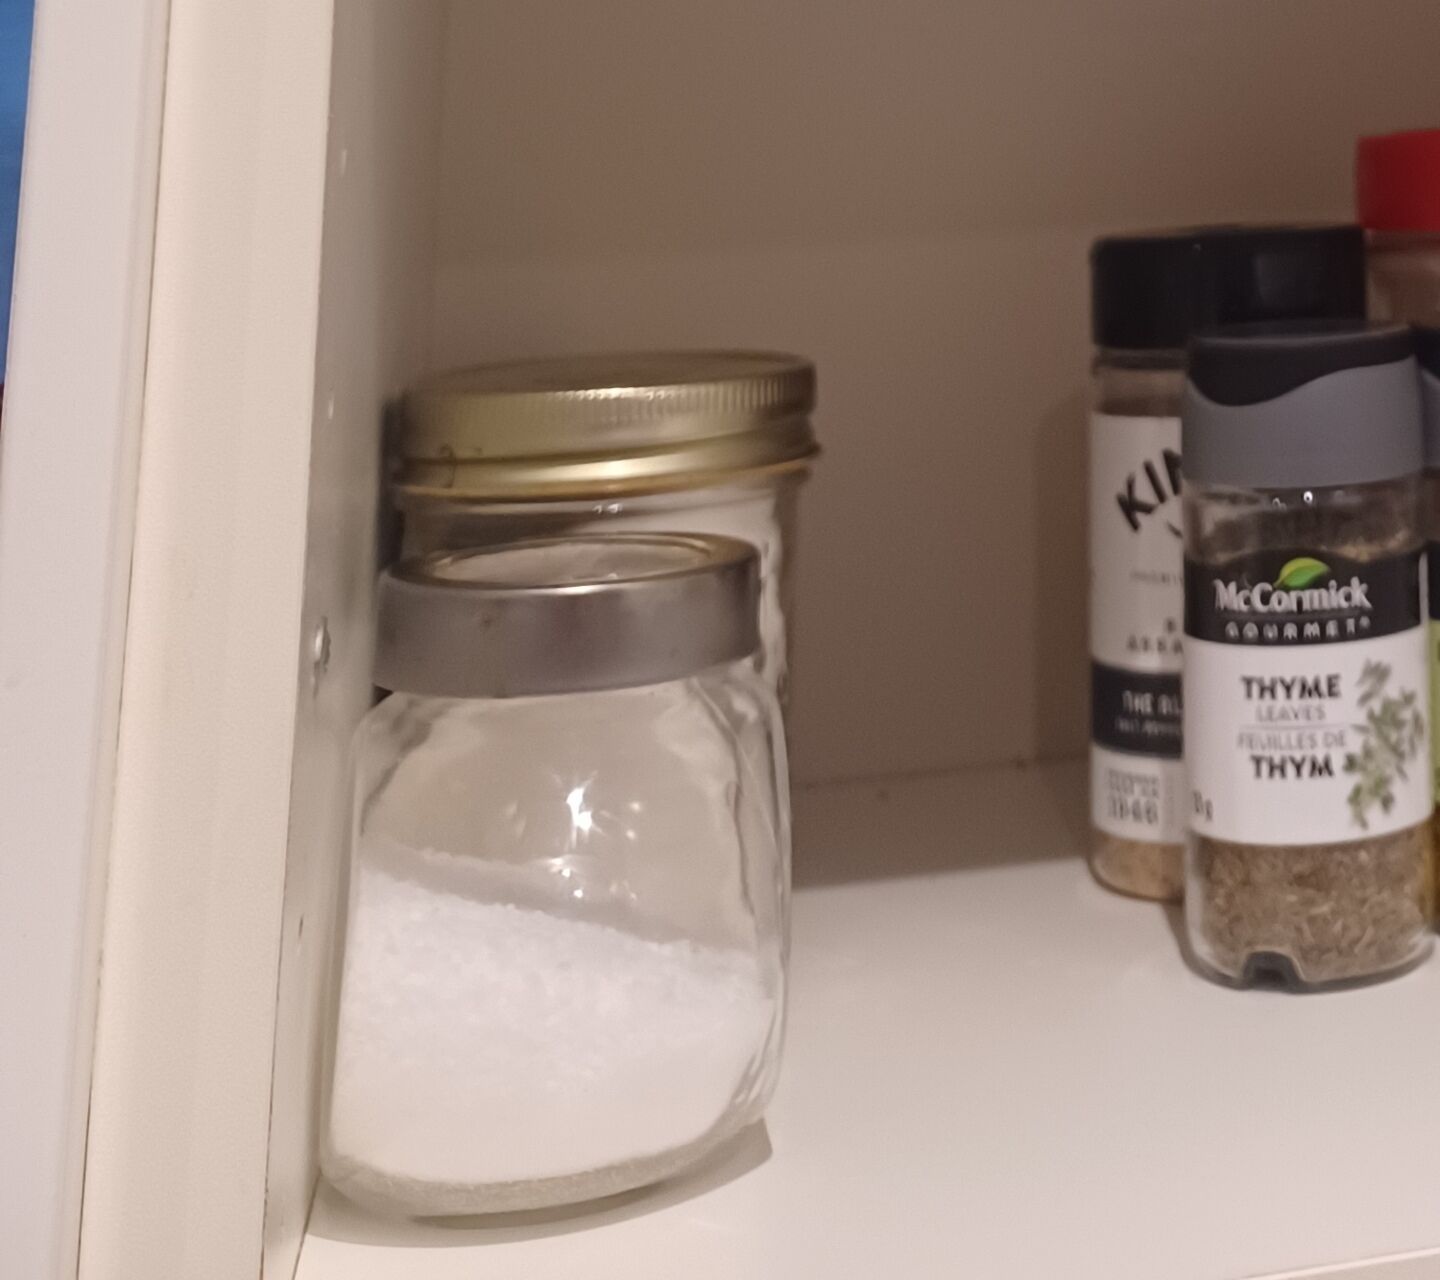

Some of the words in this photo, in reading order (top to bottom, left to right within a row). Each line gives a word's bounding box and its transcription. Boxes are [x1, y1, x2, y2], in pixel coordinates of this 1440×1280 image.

[1212, 576, 1373, 614] McCormick
[1225, 616, 1357, 640] GOURMET
[1241, 674, 1342, 702] THYME
[1256, 704, 1326, 723] LEAVES
[1238, 730, 1317, 750] FEUILLES
[1325, 730, 1346, 748] DE
[1250, 754, 1335, 780] THYM
